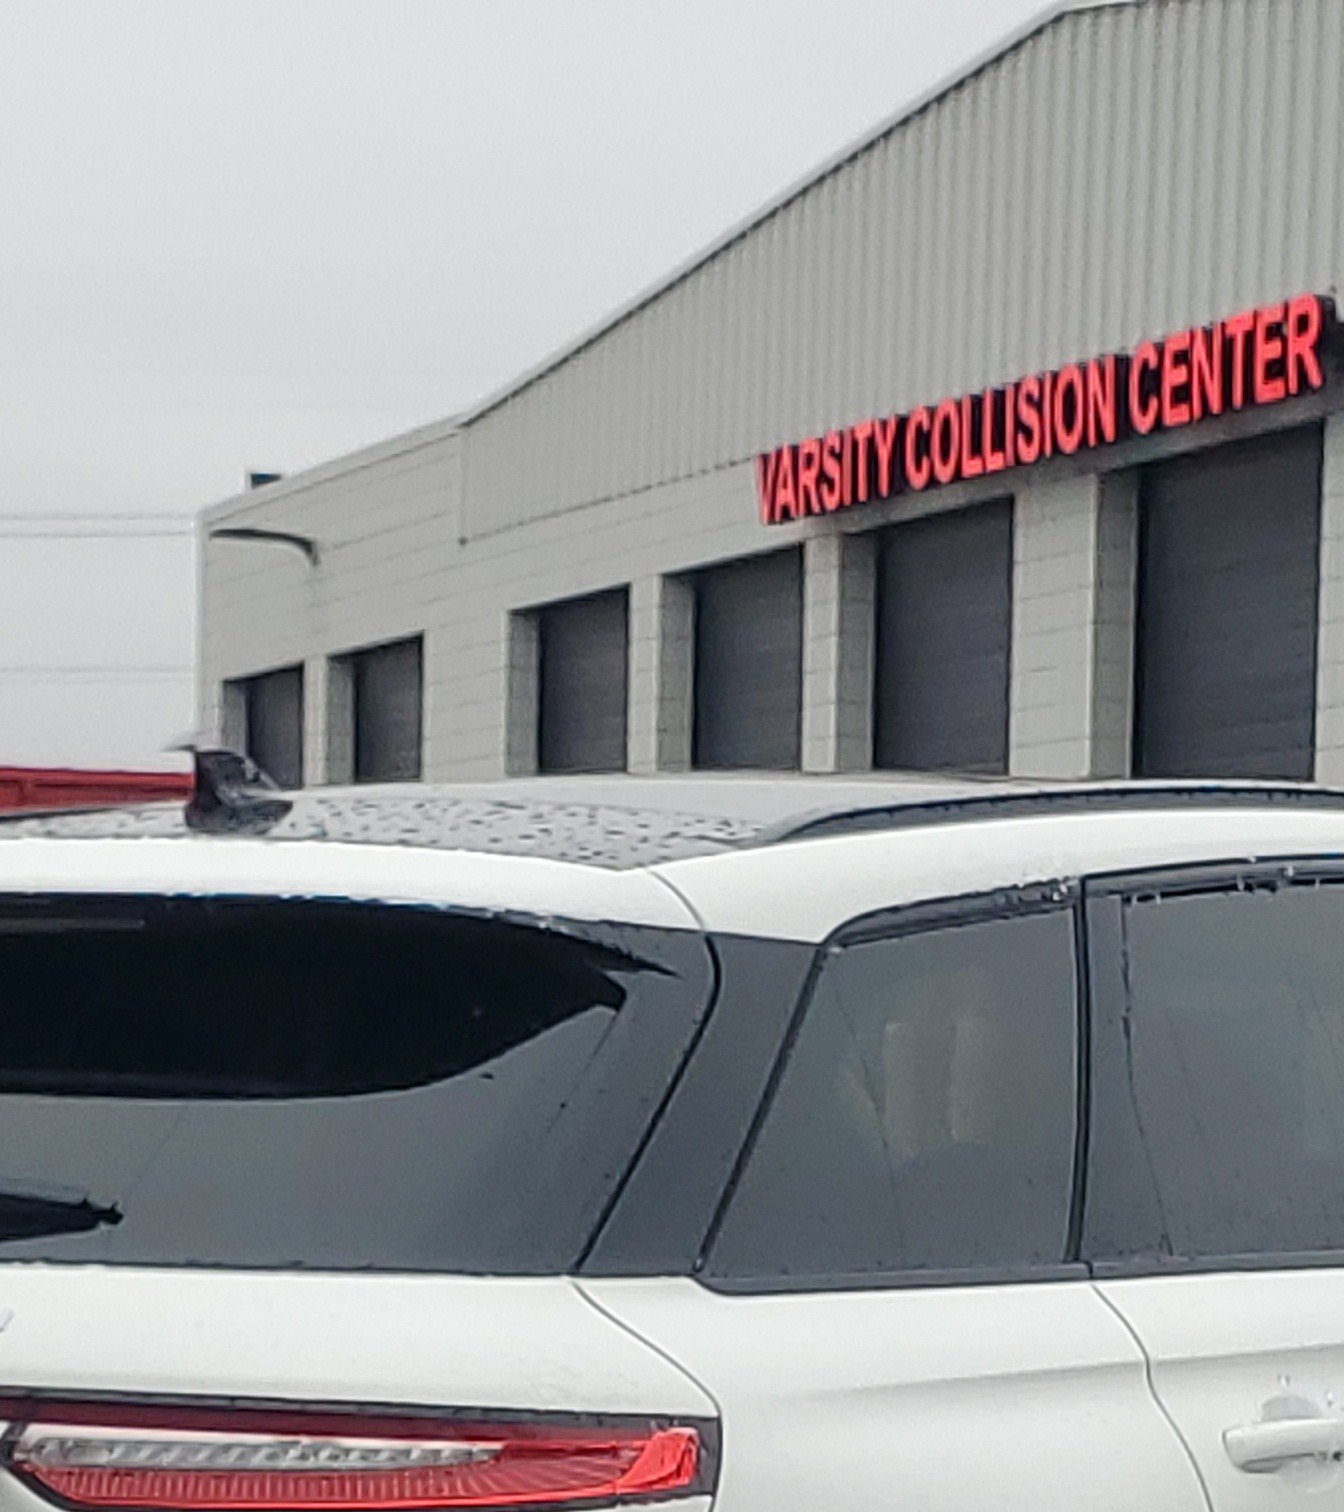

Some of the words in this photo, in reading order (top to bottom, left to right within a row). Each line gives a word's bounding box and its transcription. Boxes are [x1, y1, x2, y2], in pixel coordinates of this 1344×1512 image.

[755, 415, 898, 523] VARSITY
[903, 355, 1116, 490] COLLISION
[1128, 292, 1325, 433] CENTER
